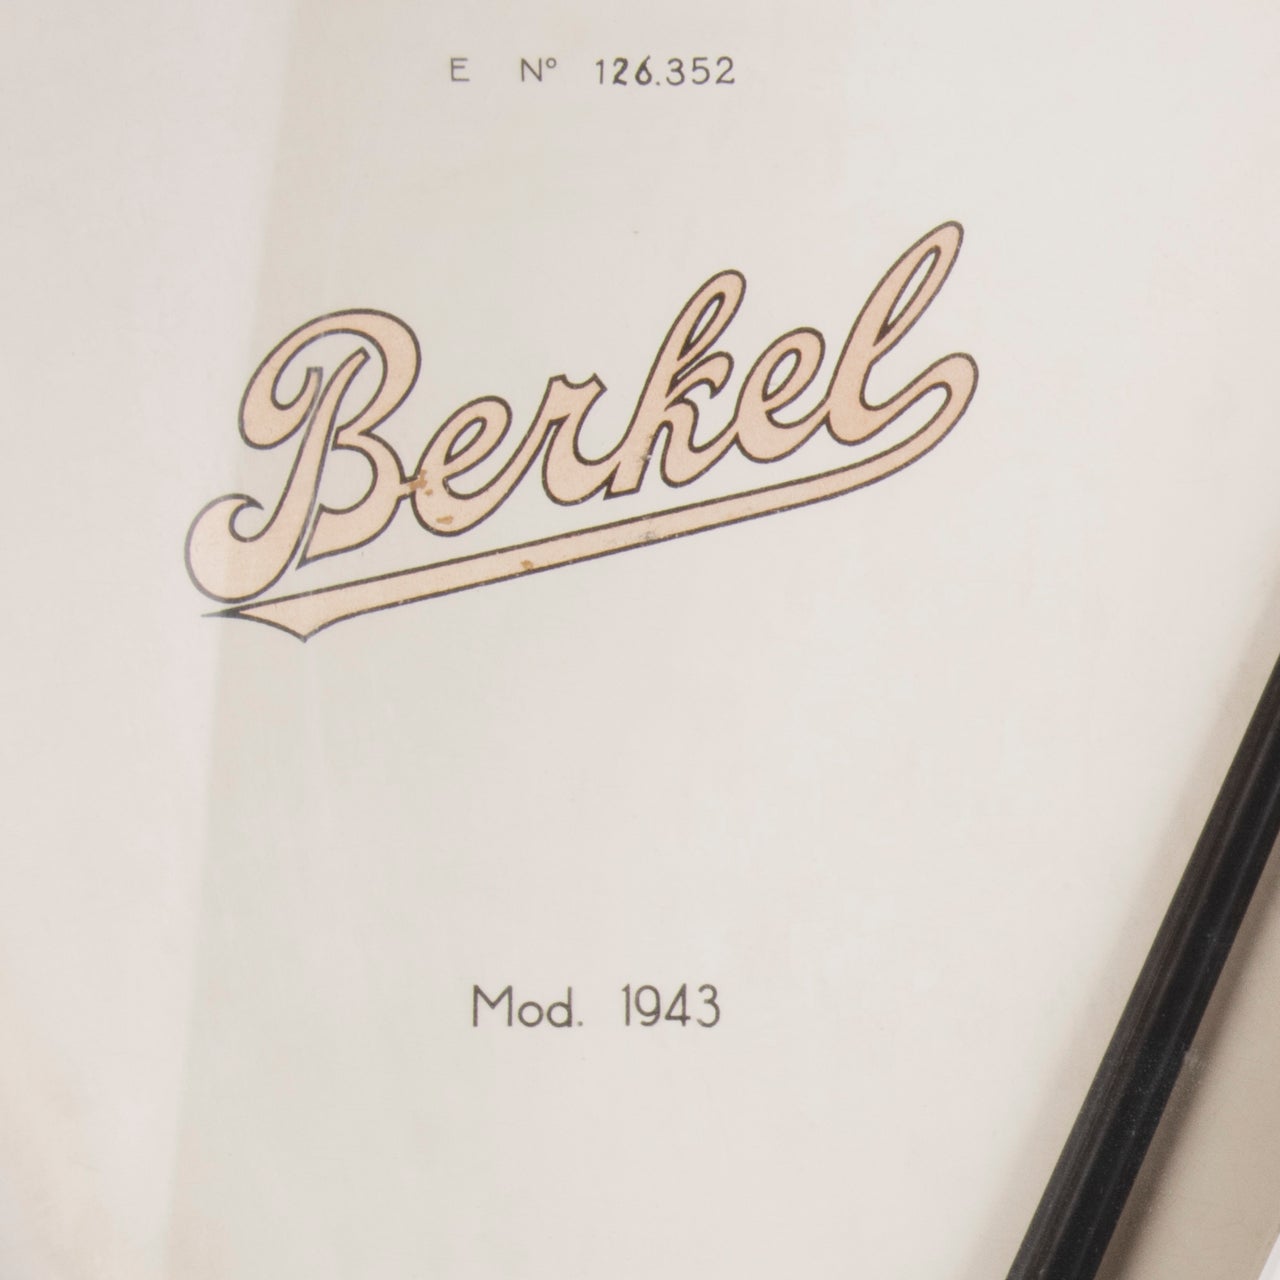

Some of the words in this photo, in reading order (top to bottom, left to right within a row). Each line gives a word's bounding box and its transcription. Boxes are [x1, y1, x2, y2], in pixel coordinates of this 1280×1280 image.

[450, 57, 470, 82] E
[596, 55, 735, 86] 126.352
[184, 220, 980, 643] Berkel
[472, 984, 583, 1028] Mod.
[621, 983, 721, 1028] 1943
